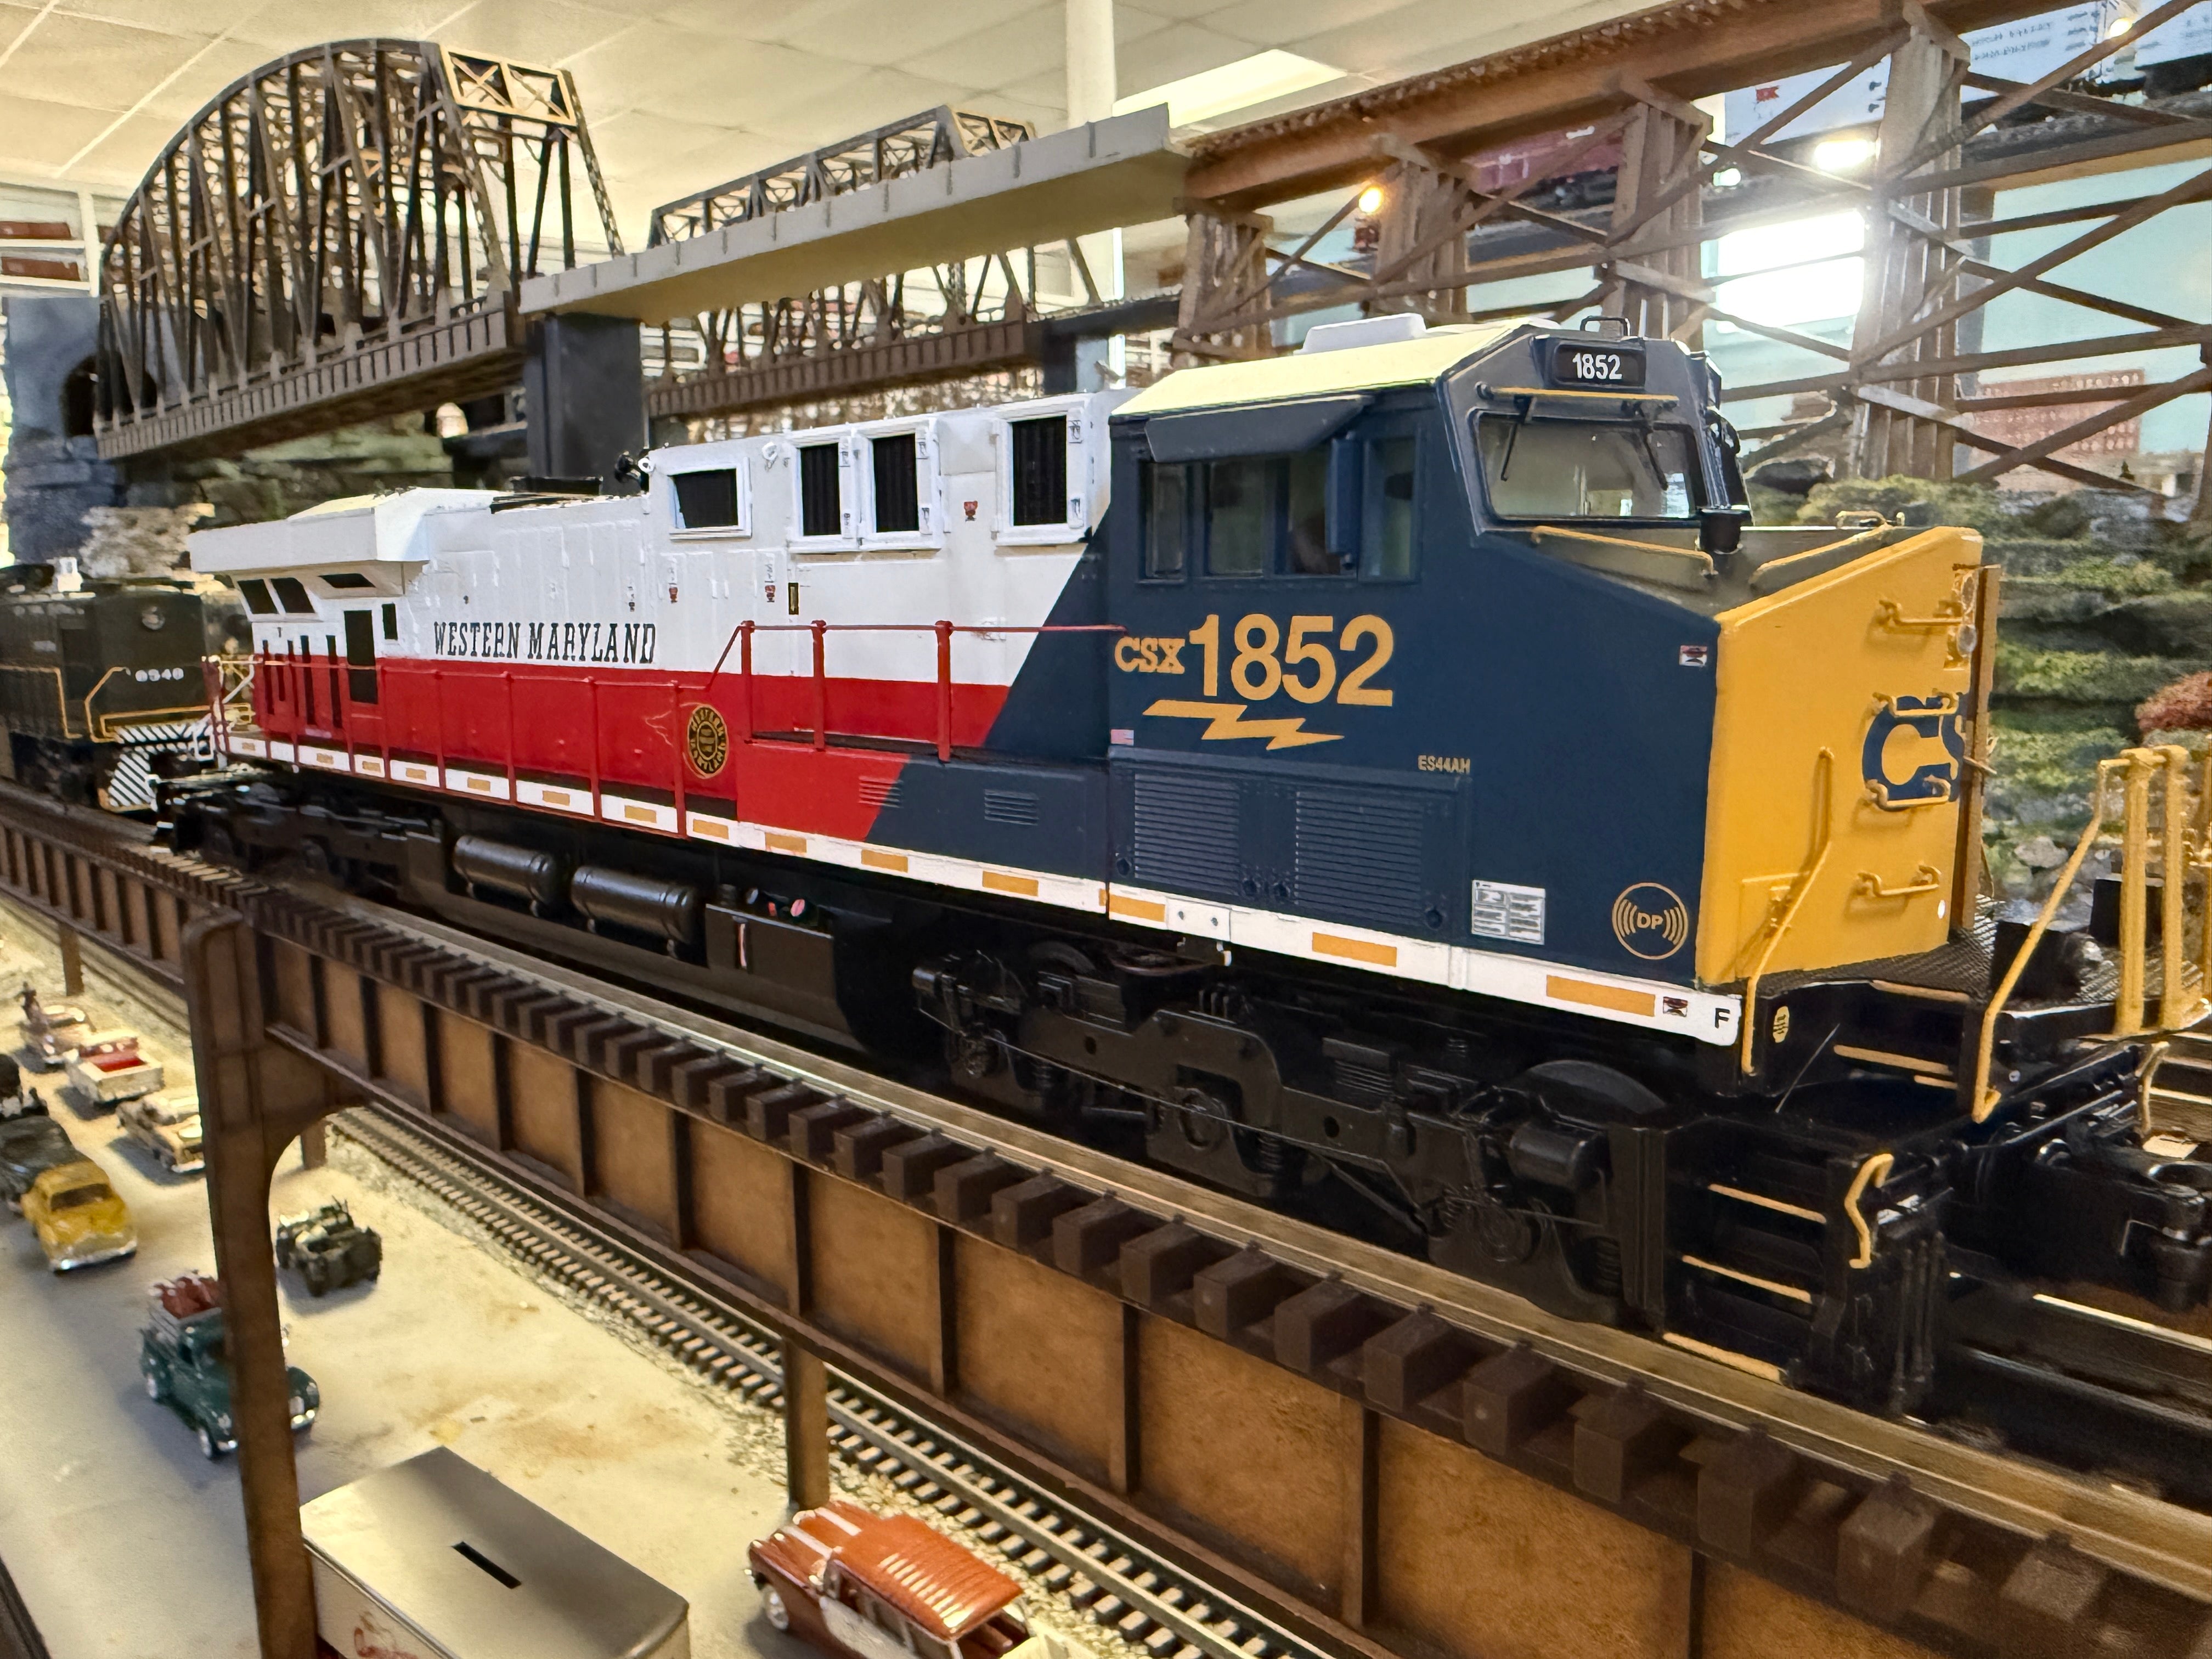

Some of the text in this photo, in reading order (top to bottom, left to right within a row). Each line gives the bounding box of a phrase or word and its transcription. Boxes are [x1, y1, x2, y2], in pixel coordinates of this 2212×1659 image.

[1572, 353, 1622, 380] 1852
[433, 621, 656, 664] WESTERN MARYLAND
[1115, 613, 1393, 707] CSX 1852
[1637, 912, 1663, 929] DP
[1714, 1007, 1730, 1028] F
